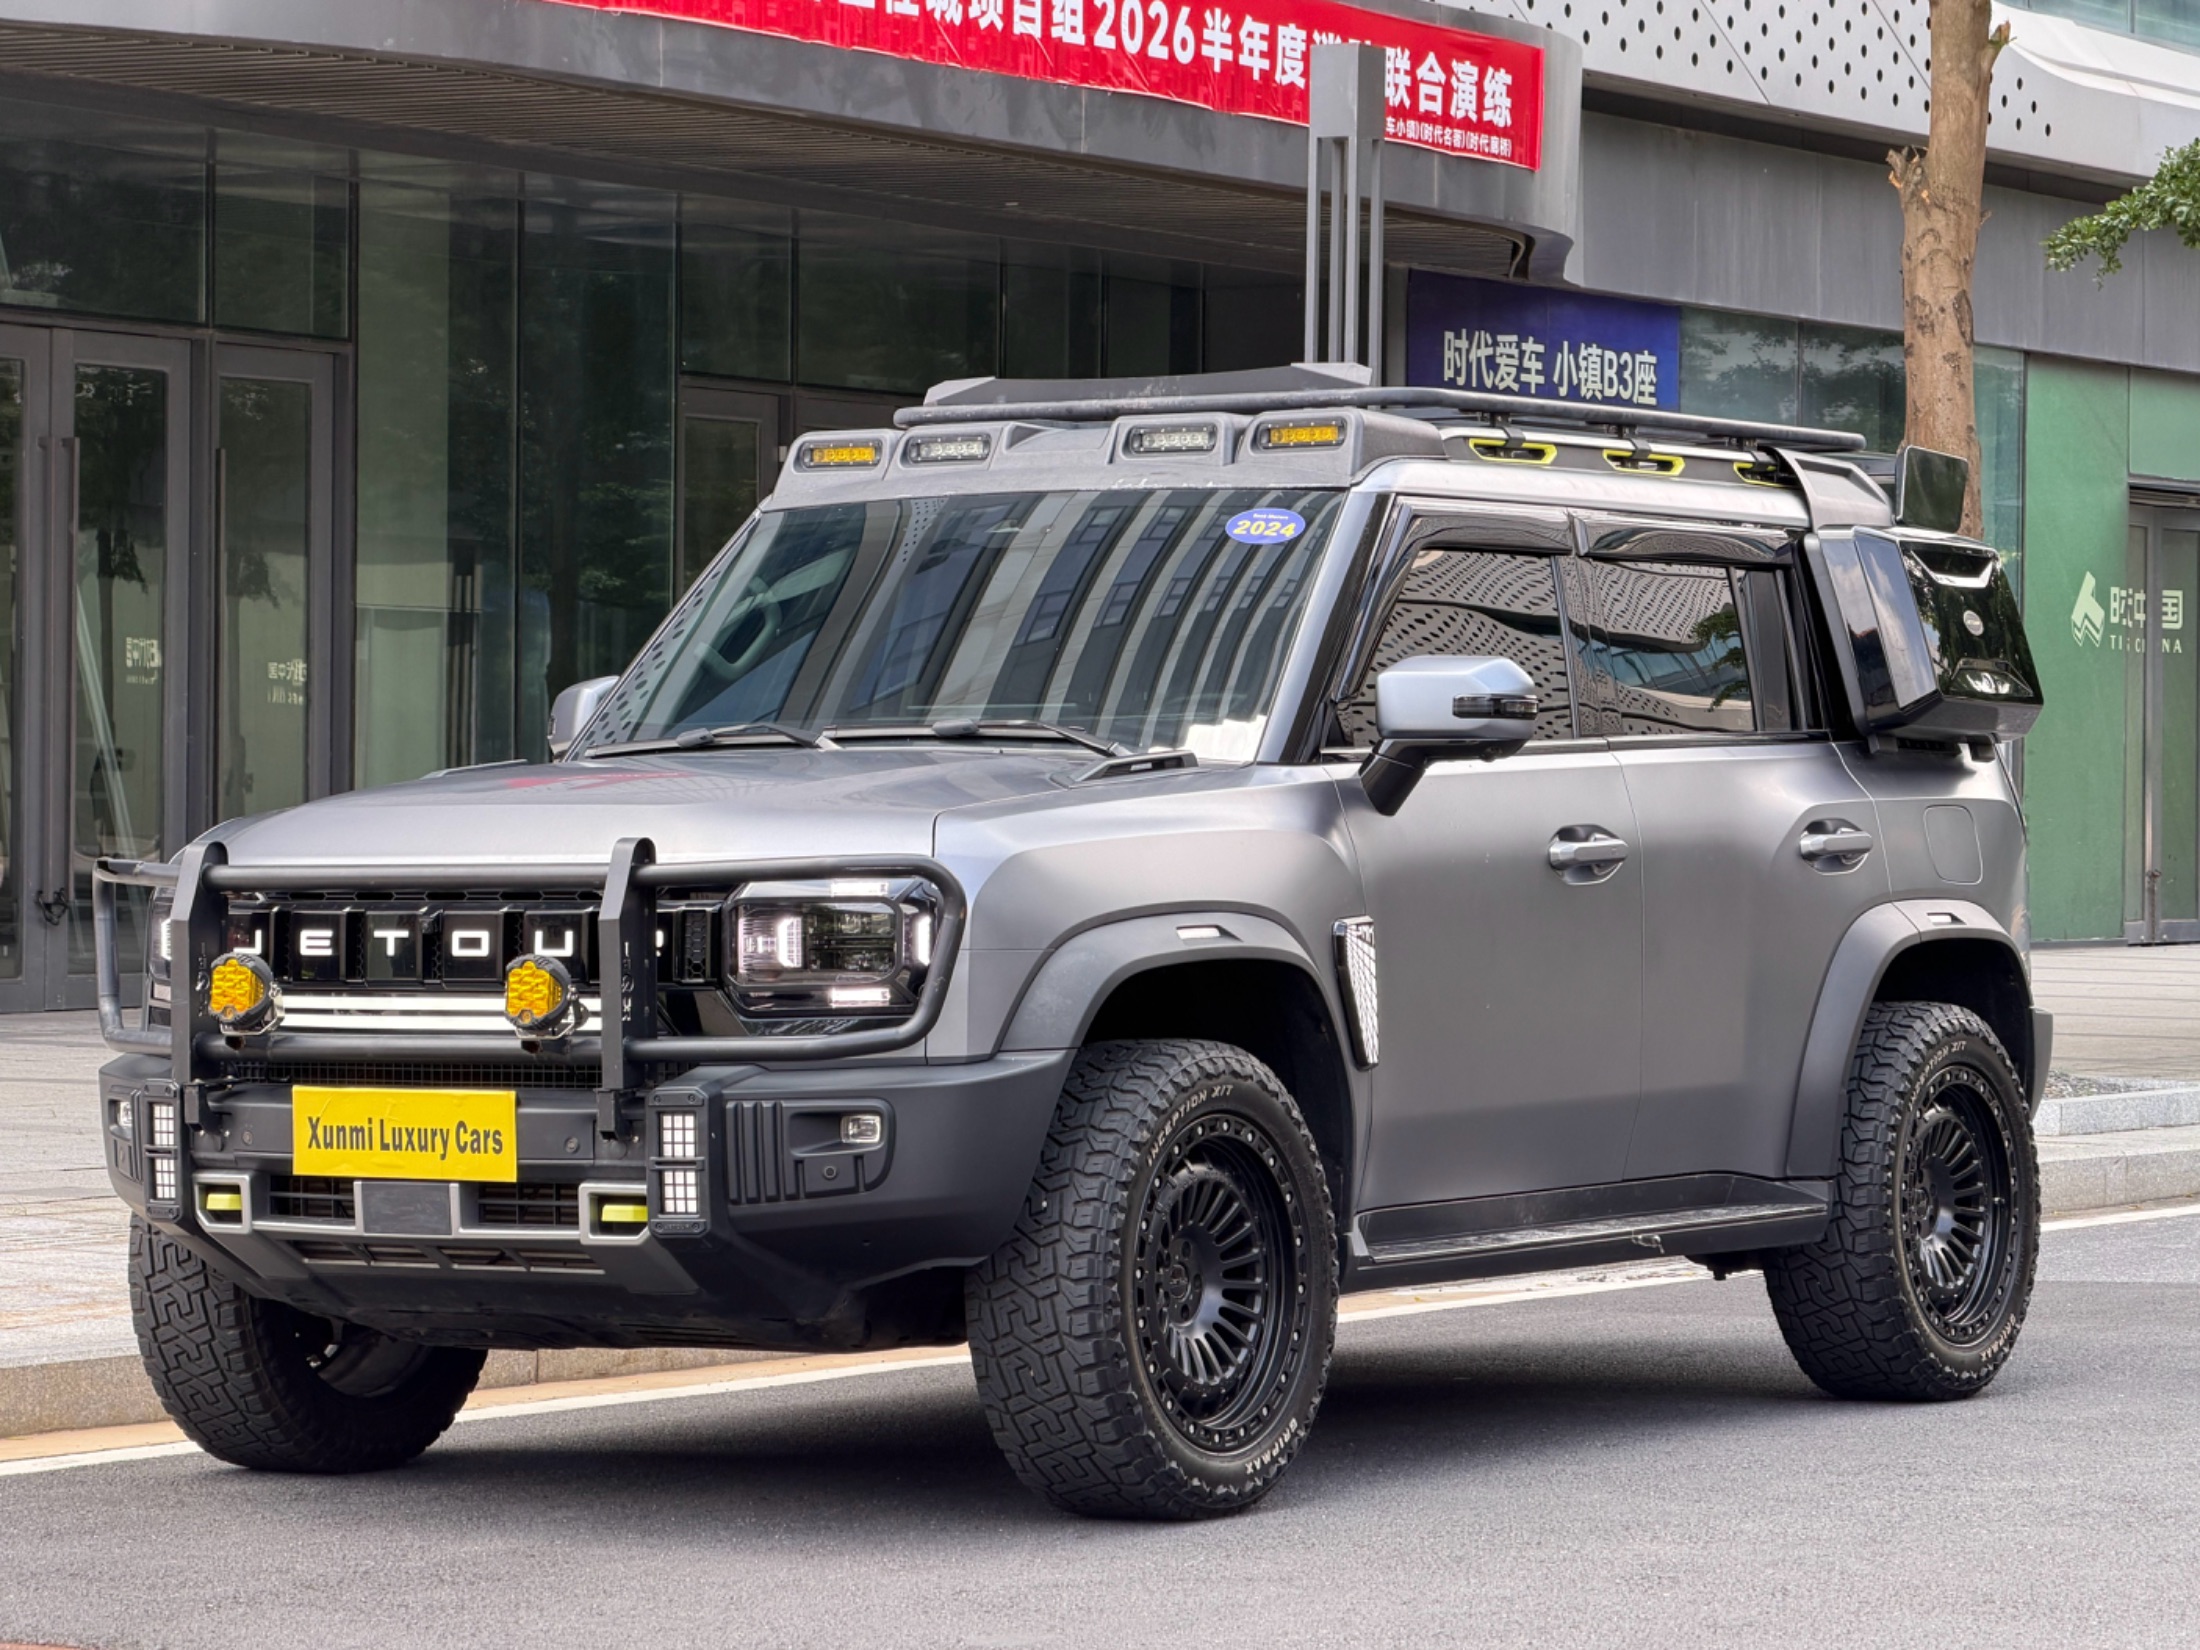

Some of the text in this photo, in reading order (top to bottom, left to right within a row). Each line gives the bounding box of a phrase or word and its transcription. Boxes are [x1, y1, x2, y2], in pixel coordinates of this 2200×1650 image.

[1443, 328, 1658, 407] 时代爱车 小镇B3座
[1232, 519, 1297, 538] 2024
[233, 929, 664, 958] JETOU
[307, 1115, 504, 1161] Xunmi Luxury Cars
[1146, 1084, 1234, 1168] INCEPTION X/T
[1244, 1416, 1299, 1475] GRIPMAX
